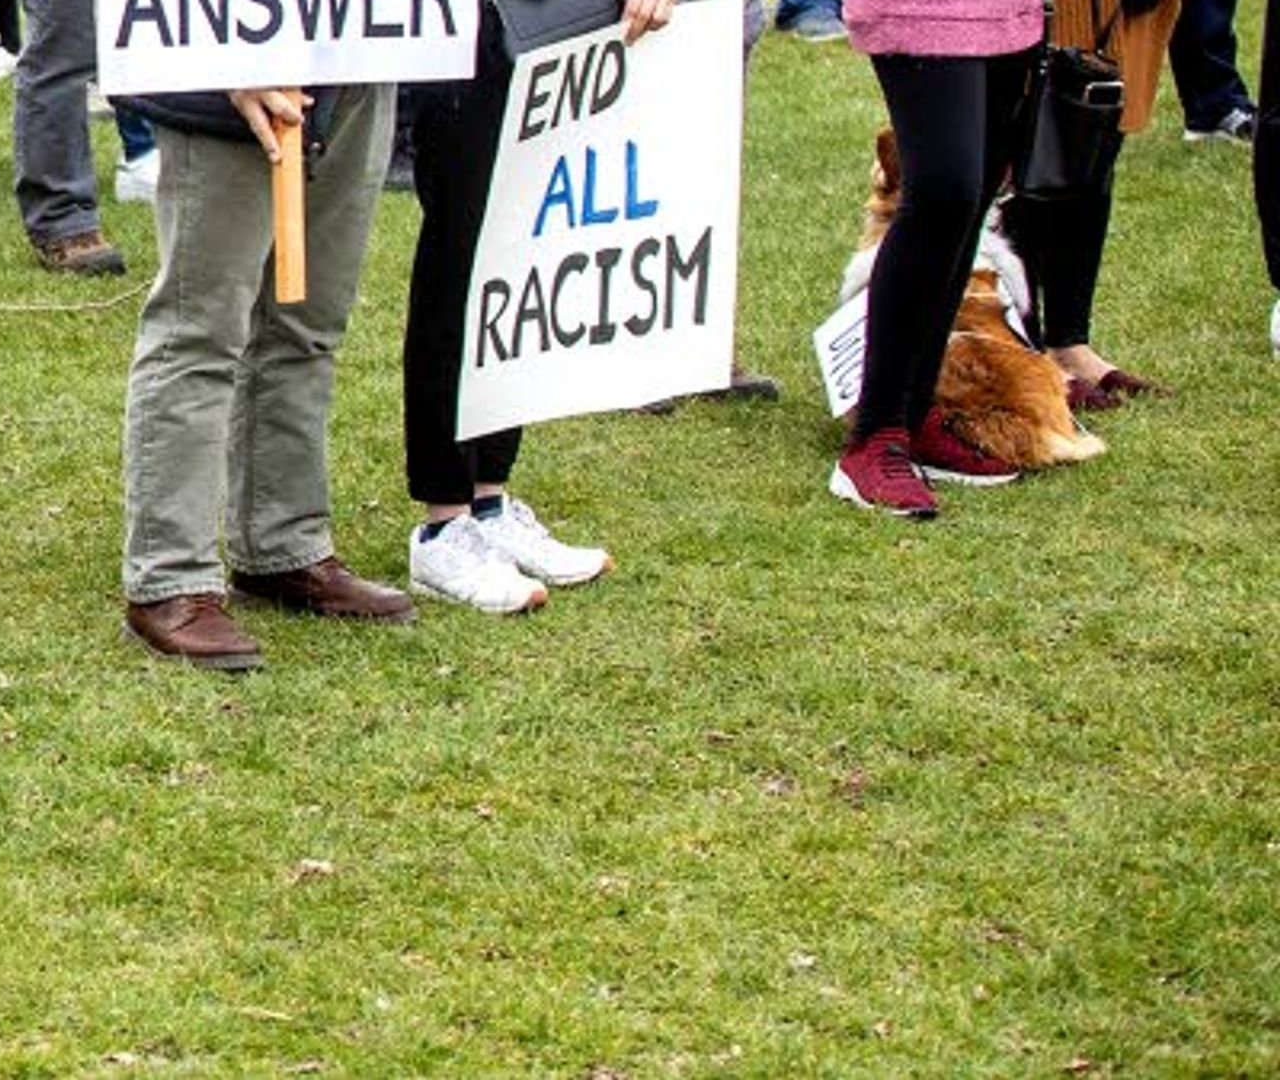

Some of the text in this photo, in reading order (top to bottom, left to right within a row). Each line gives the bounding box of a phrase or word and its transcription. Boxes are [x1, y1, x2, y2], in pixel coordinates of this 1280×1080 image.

[518, 39, 627, 142] END
[531, 139, 659, 238] ALL
[476, 226, 713, 368] RACISM
